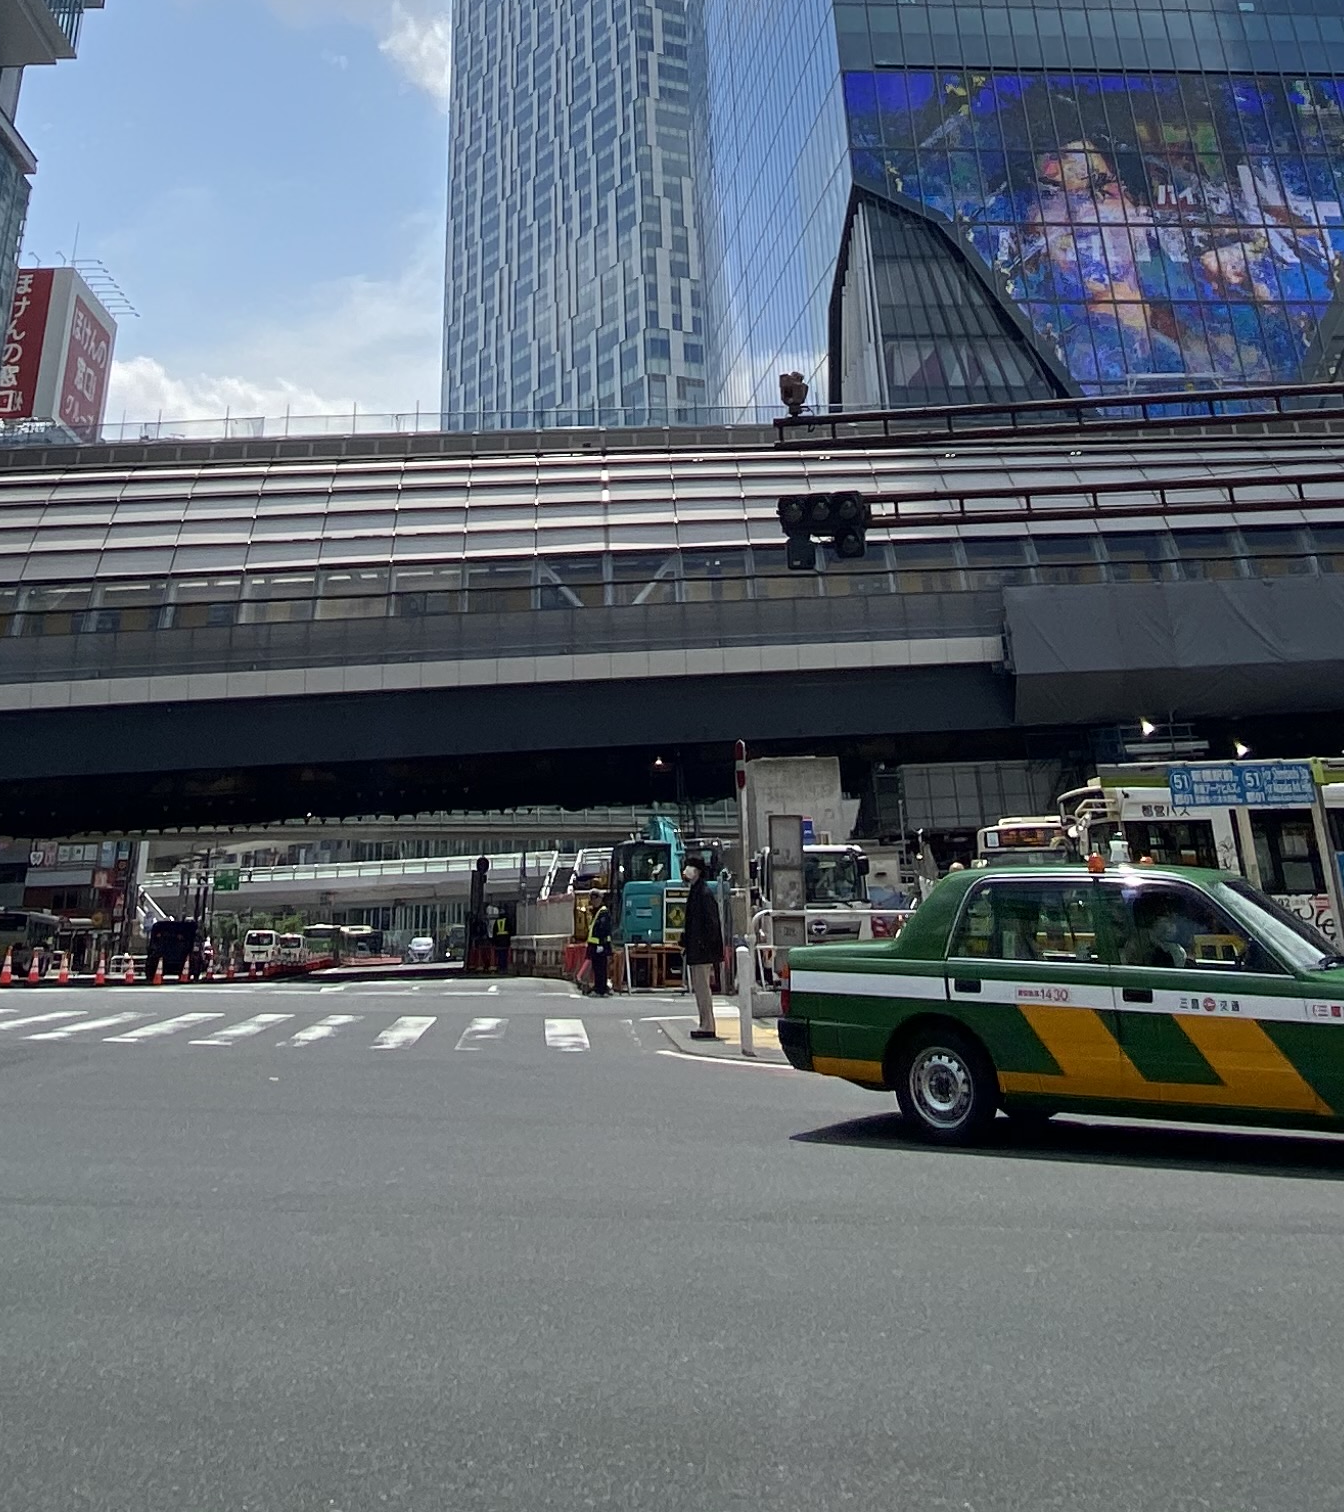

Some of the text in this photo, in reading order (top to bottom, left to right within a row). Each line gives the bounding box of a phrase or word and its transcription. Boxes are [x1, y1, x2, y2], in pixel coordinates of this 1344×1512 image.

[71, 309, 107, 369] ほけんの
[1173, 774, 1190, 789] 51
[1244, 772, 1261, 788] 51
